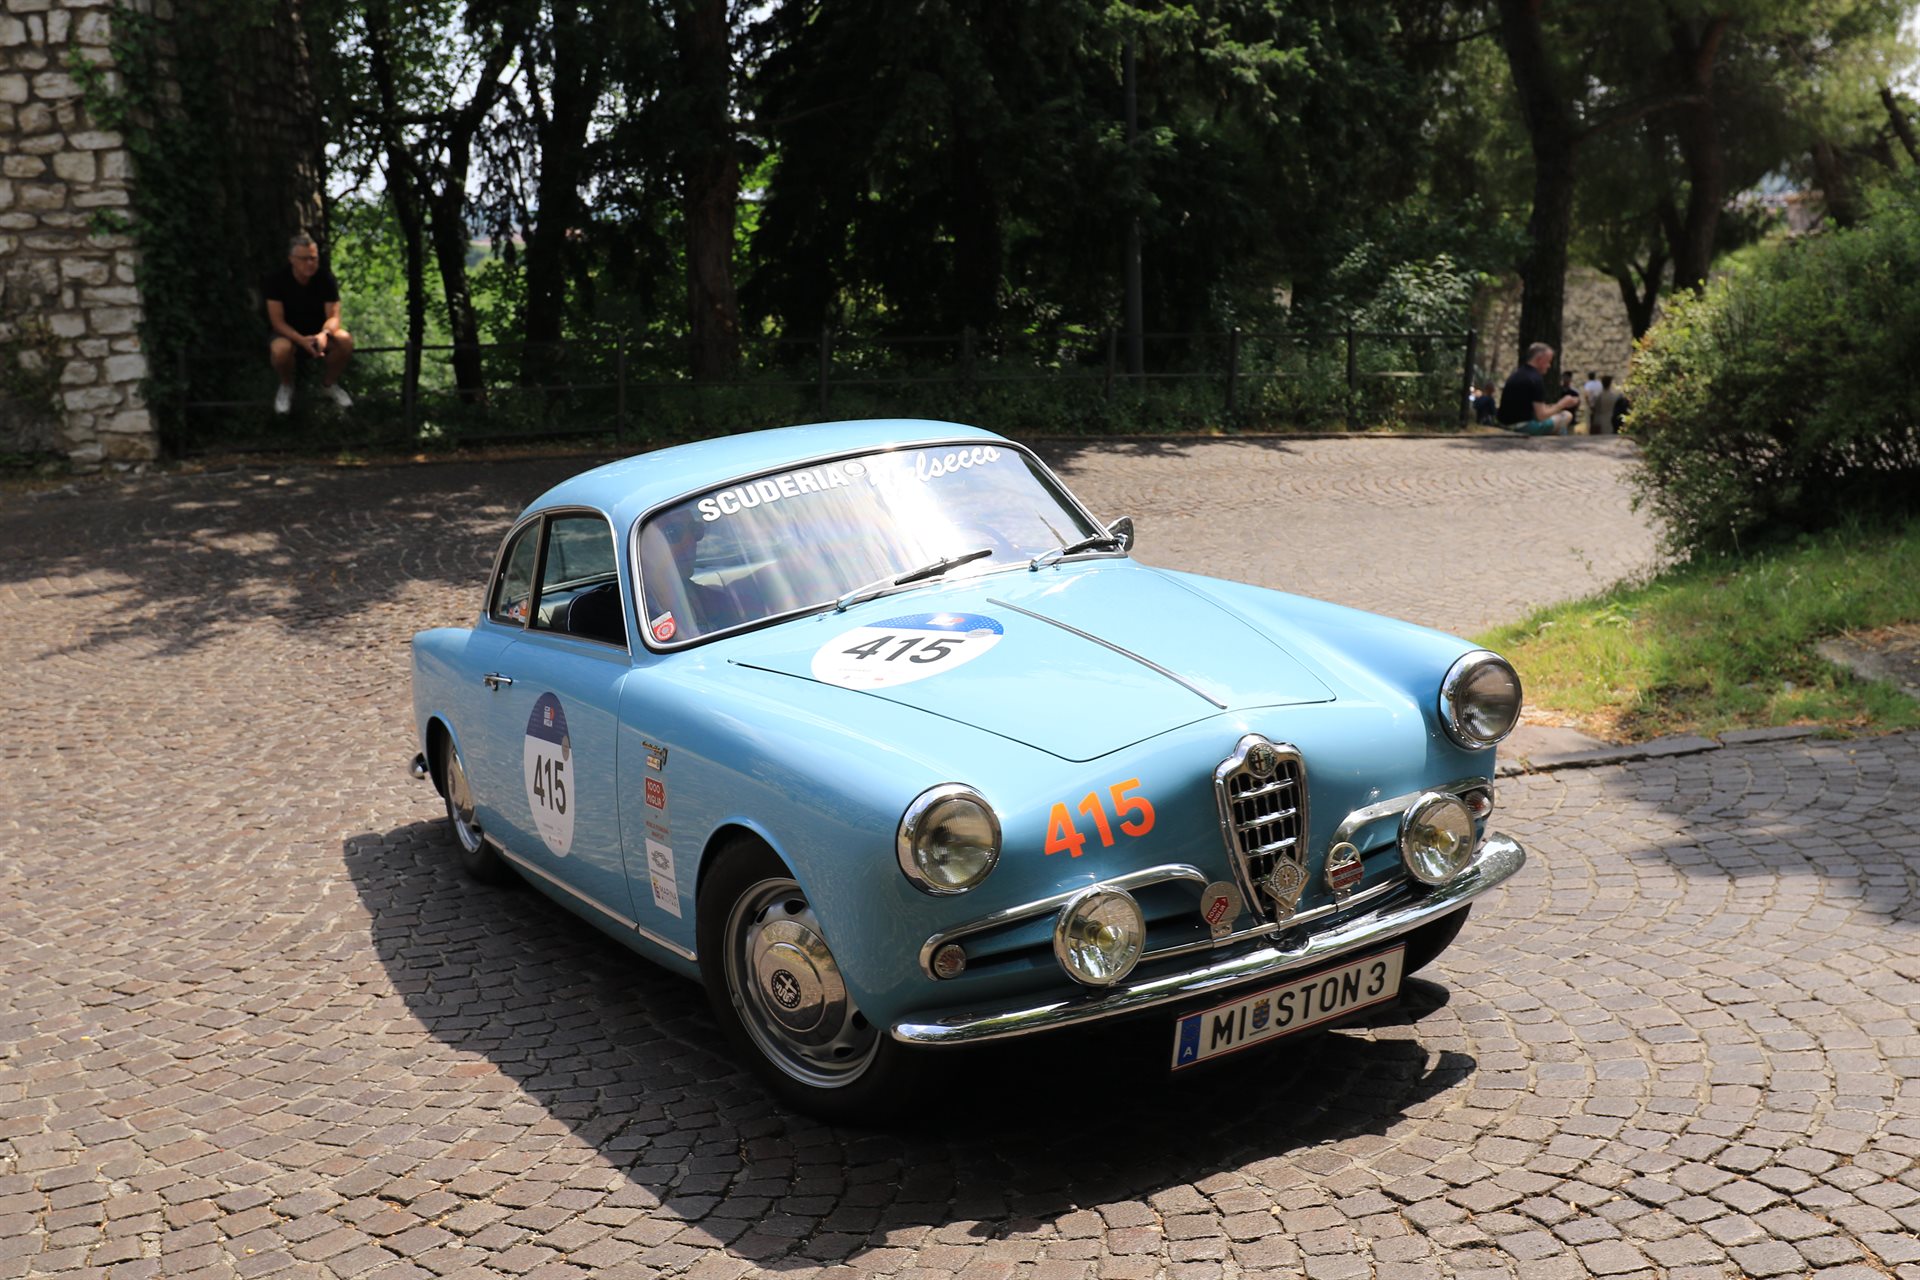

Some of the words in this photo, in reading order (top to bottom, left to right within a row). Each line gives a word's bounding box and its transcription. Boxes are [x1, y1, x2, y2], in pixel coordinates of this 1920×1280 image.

[697, 467, 849, 522] SCUDERIA
[841, 635, 966, 664] 415
[533, 754, 567, 815] 415
[1044, 777, 1156, 858] 415
[1183, 1046, 1193, 1058] A
[1210, 1005, 1247, 1050] MI
